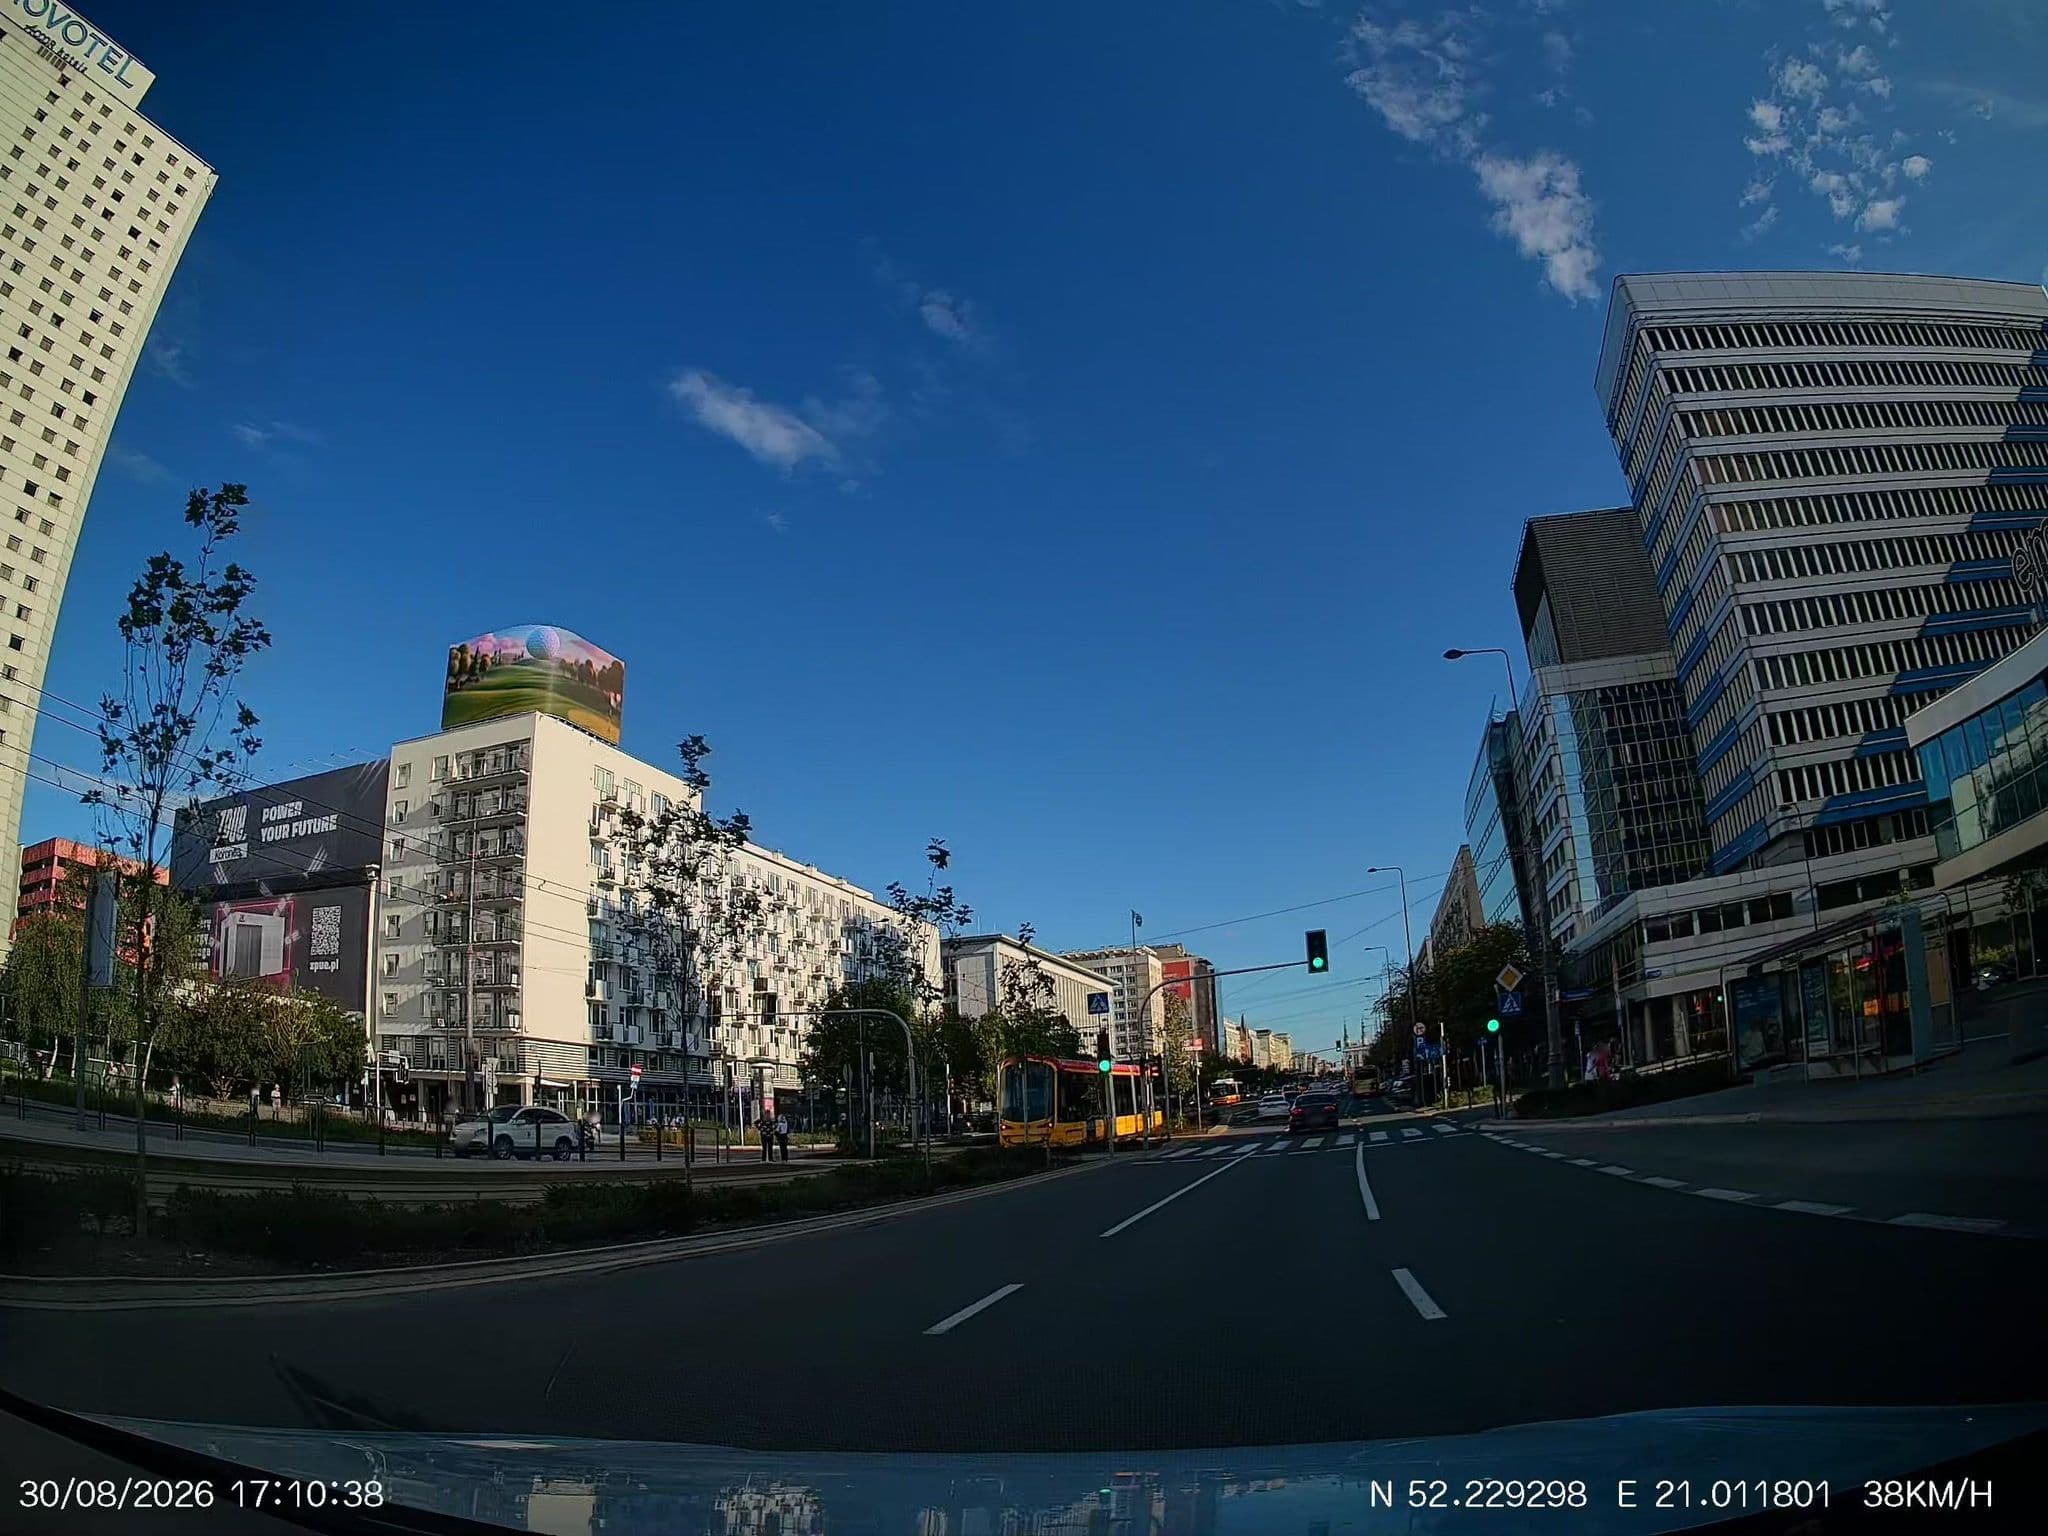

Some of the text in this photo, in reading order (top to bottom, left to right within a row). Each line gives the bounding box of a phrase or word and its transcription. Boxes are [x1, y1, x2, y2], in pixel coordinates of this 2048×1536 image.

[13, 0, 134, 89] OVOTEL
[262, 801, 303, 823] POWER
[260, 814, 339, 843] YOUR FUTURE
[309, 958, 339, 973] zpue.pl
